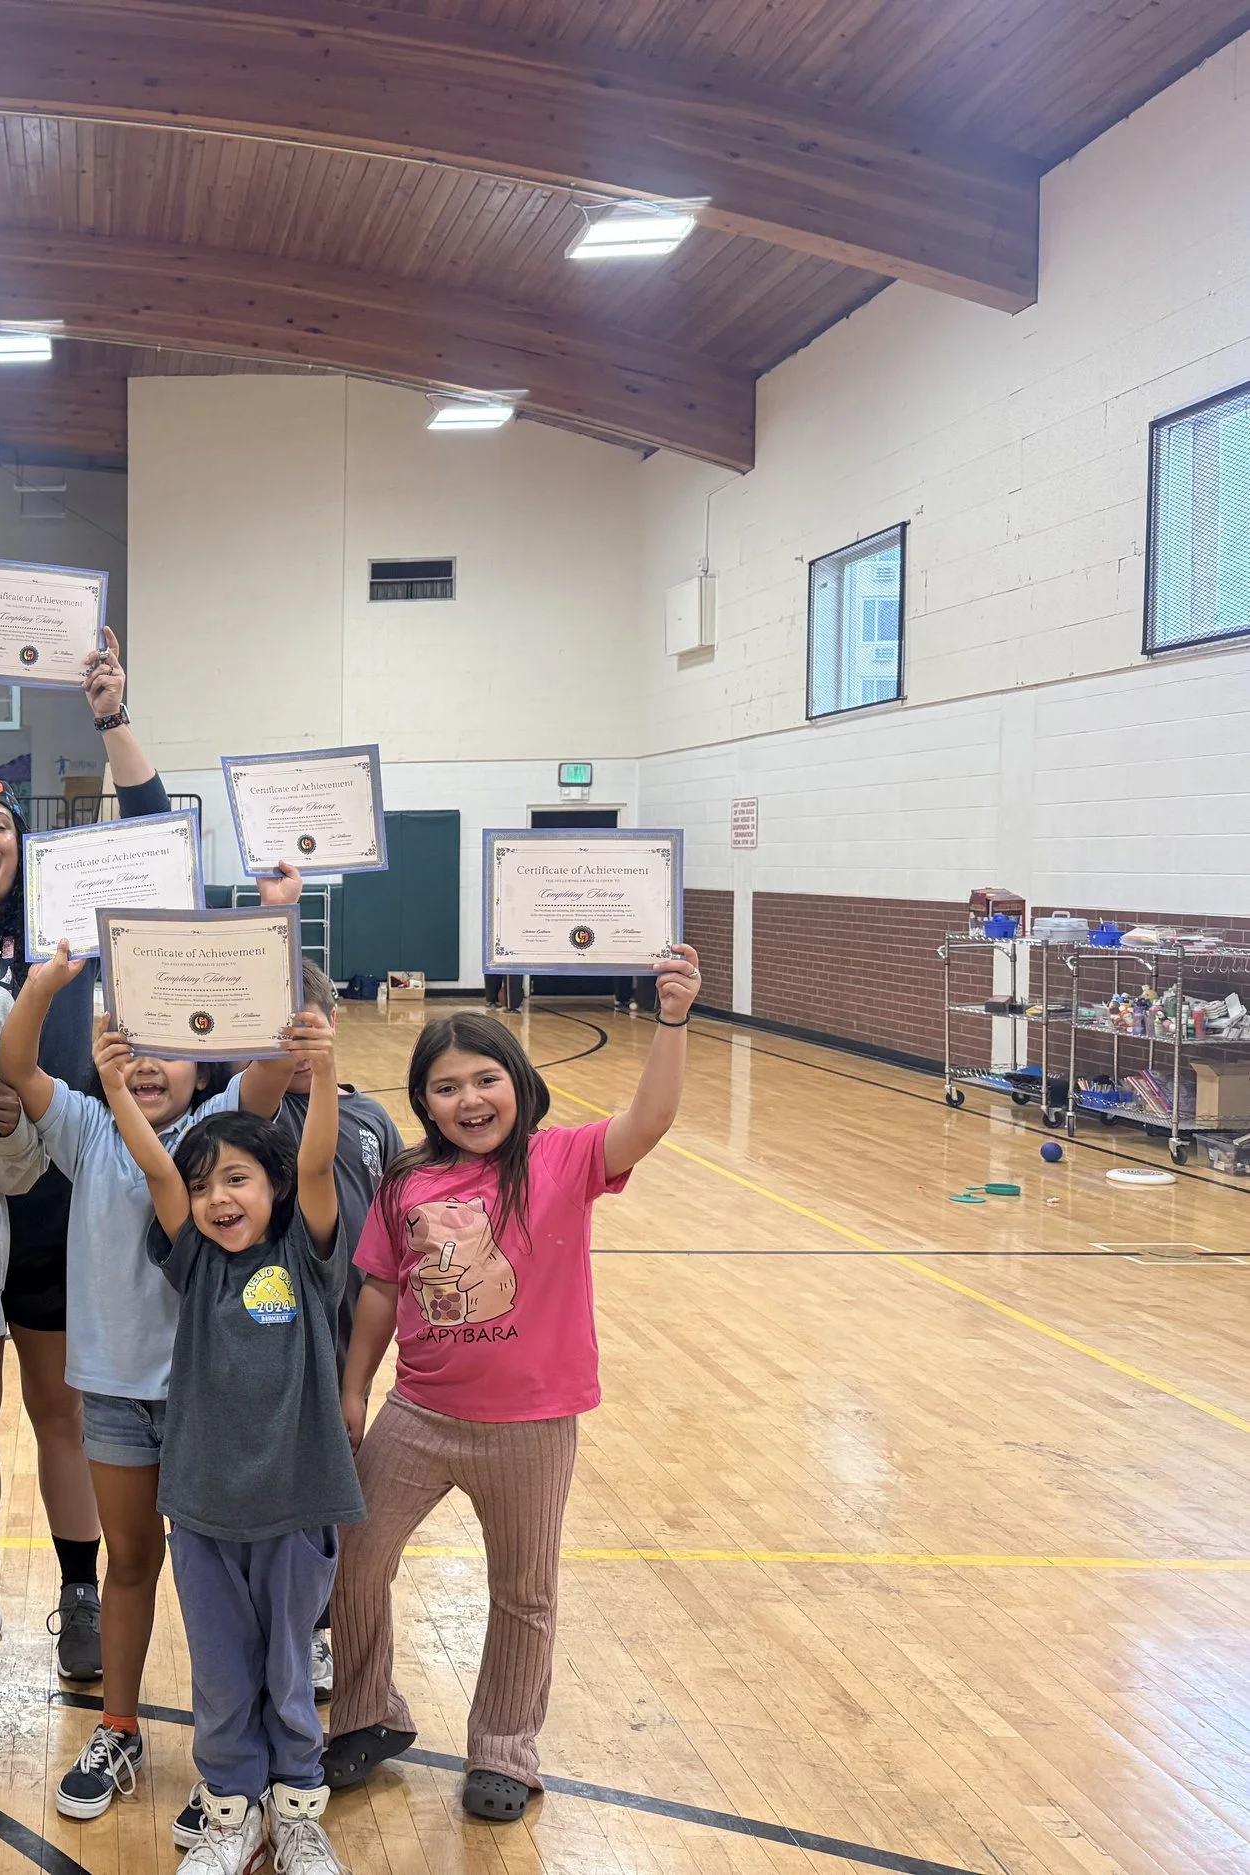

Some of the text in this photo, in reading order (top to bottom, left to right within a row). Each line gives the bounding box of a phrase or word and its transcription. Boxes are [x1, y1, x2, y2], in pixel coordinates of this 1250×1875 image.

[25, 594, 34, 602] of
[34, 595, 82, 606] Achievement
[35, 614, 63, 627] Tutoring
[250, 780, 352, 795] Certificate of Achievement
[269, 801, 335, 814] Completing Tutoring
[55, 847, 169, 870] Certificate of Achievement
[517, 865, 648, 874] Certificate of Achievement
[74, 872, 149, 889] Completing Tutoring
[538, 888, 624, 900] Completing Tutoring
[133, 947, 265, 958] Certificate of Achievement
[156, 971, 241, 985] Completing Tutoring
[245, 1267, 274, 1299] FIELD
[256, 1300, 291, 1313] 2024
[416, 1325, 519, 1344] CAPYBARA
